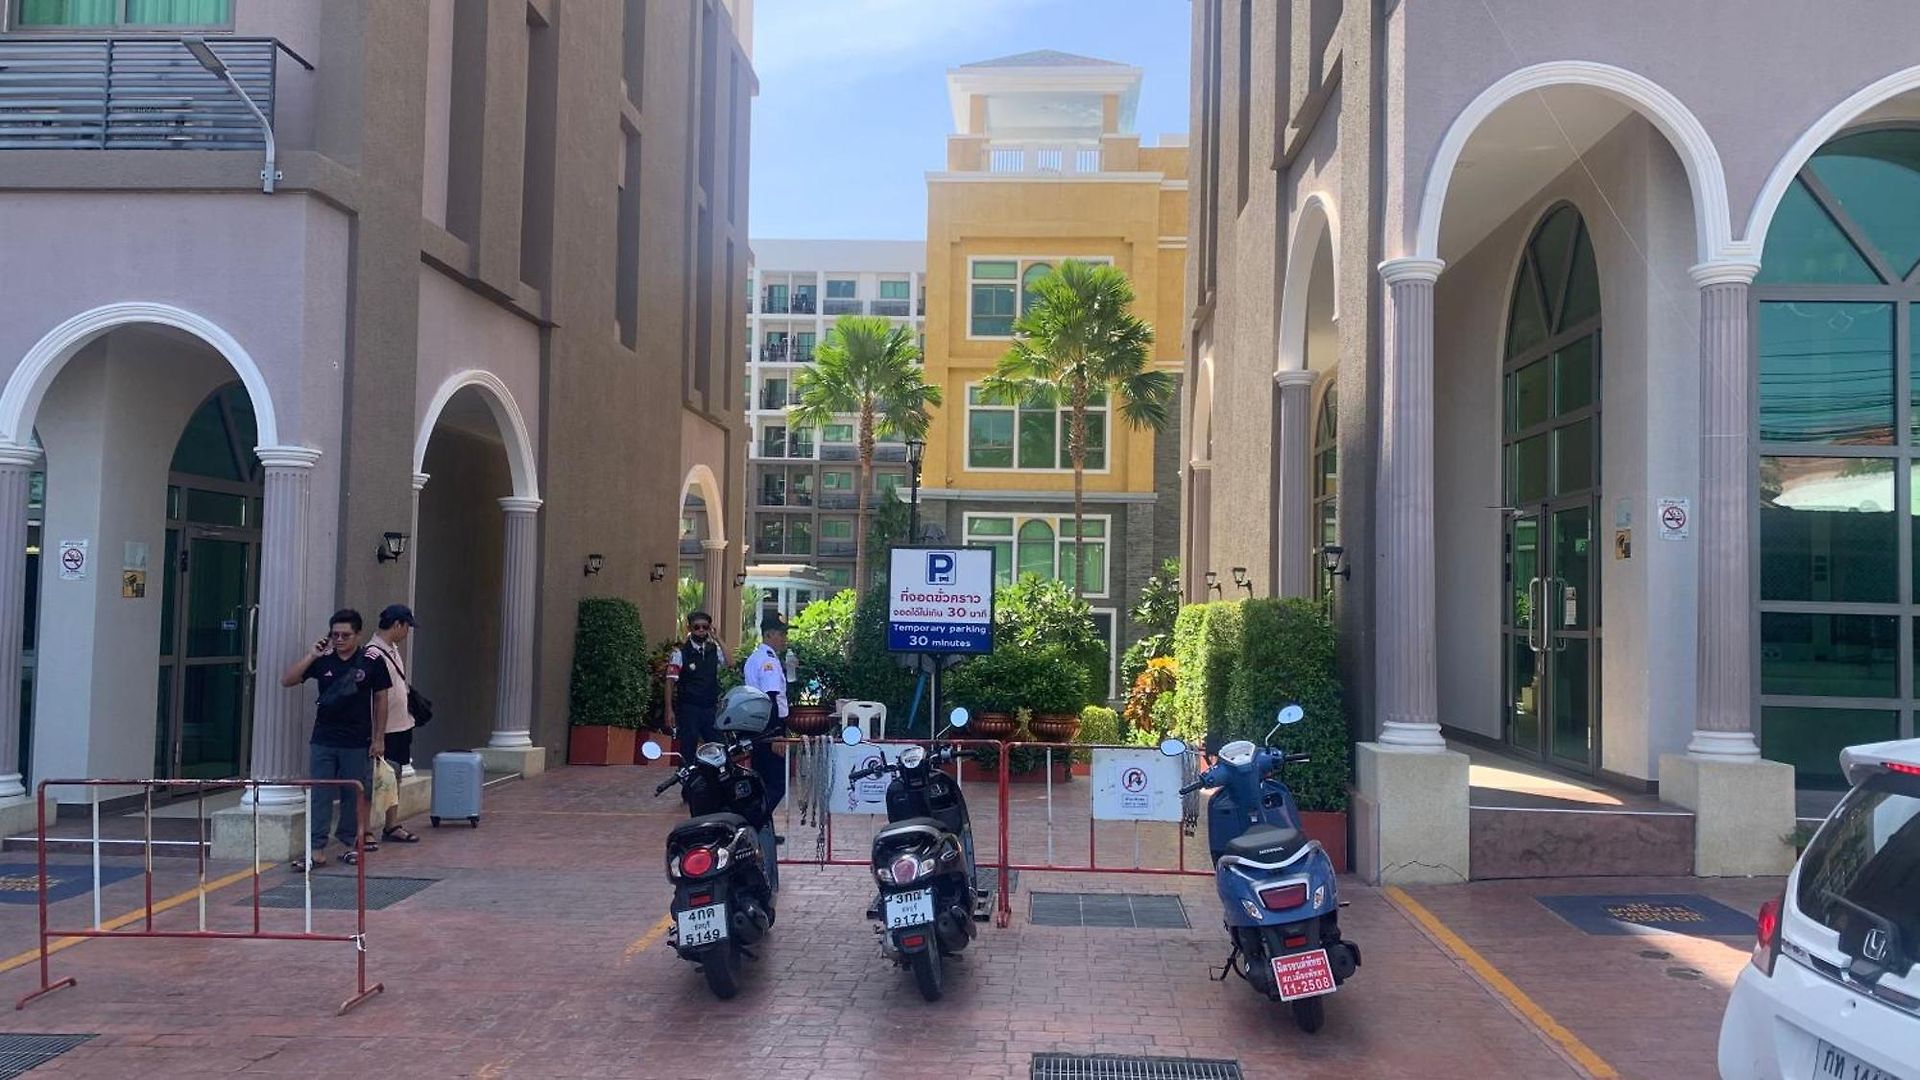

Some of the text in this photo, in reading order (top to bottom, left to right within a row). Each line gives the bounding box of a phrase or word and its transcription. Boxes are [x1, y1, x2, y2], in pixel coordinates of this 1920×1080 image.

[929, 554, 953, 582] P
[901, 587, 981, 603] ที่จอดชั่วคราว
[948, 608, 966, 618] 30
[893, 624, 987, 635] Temporary parking
[909, 635, 971, 647] 30 minutes
[894, 912, 926, 926] 9171
[685, 928, 720, 947] 5149
[1283, 976, 1330, 995] 11-2508
